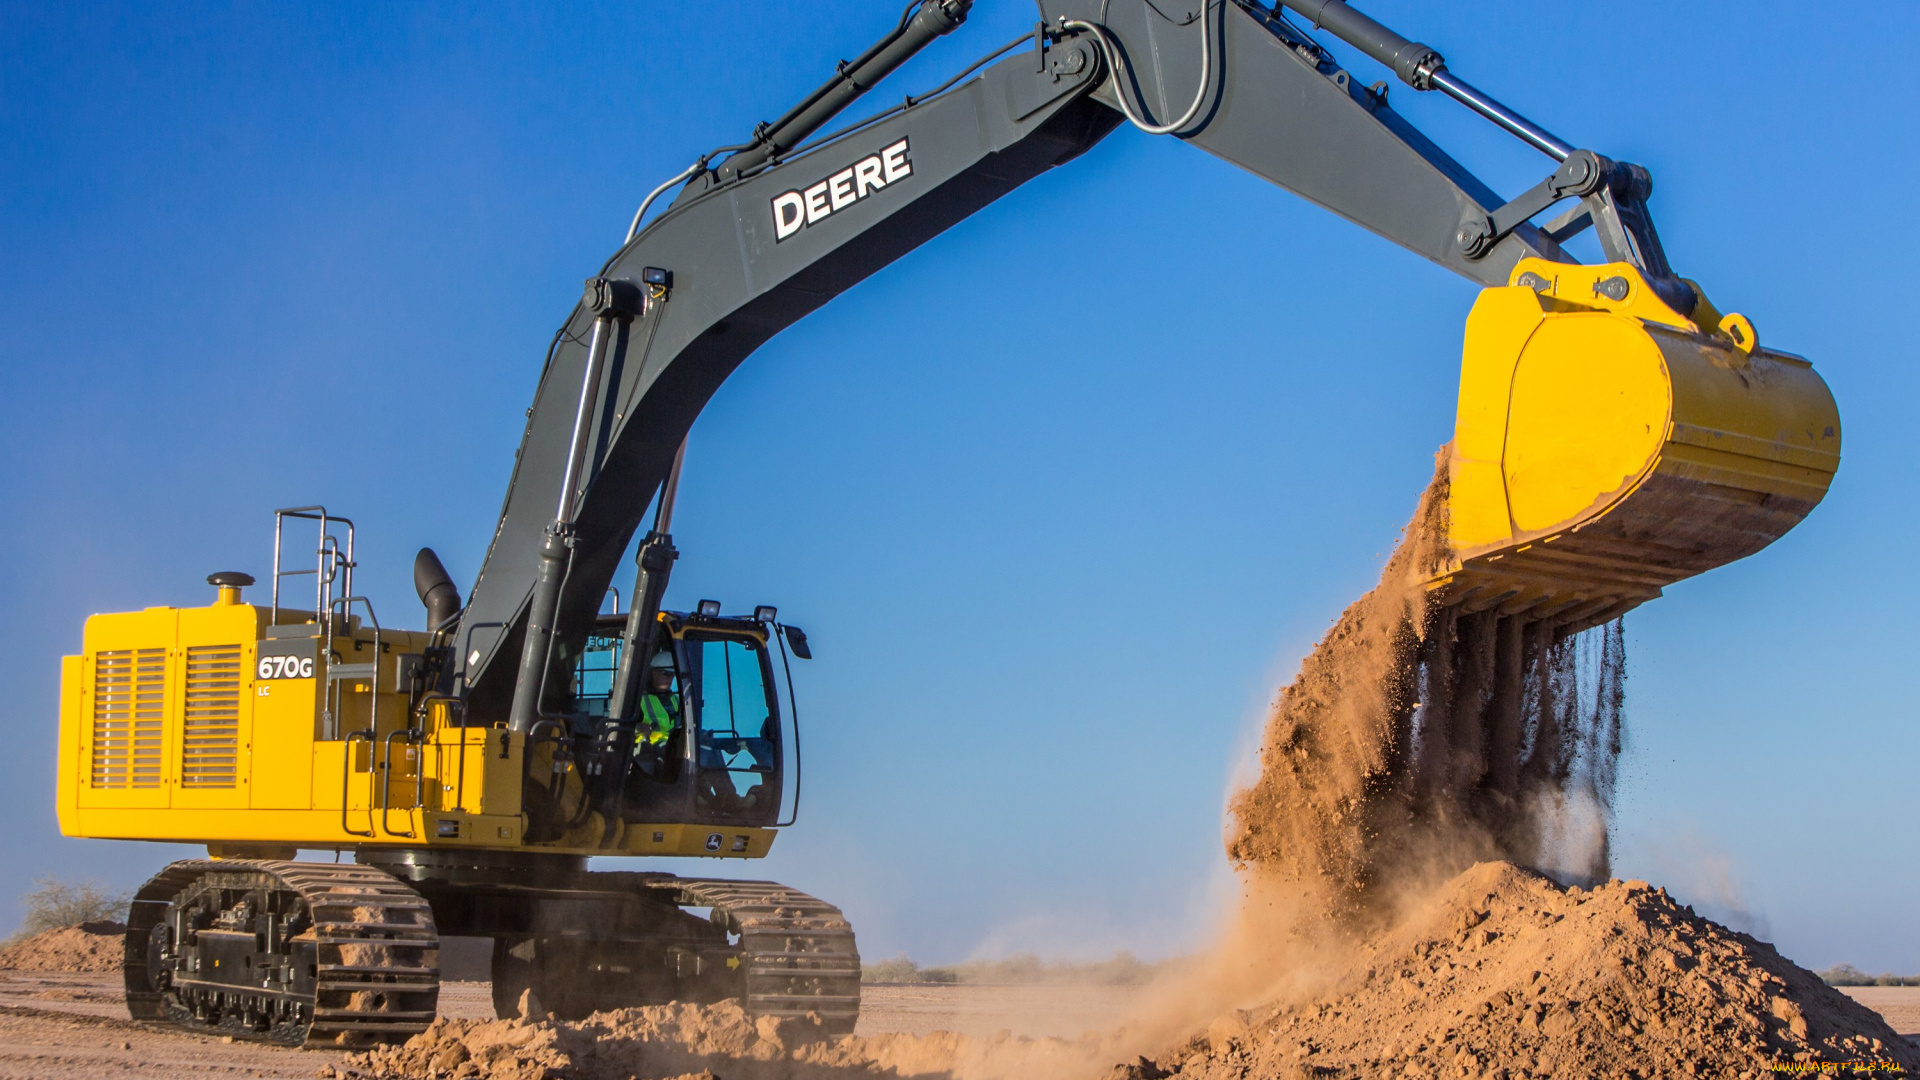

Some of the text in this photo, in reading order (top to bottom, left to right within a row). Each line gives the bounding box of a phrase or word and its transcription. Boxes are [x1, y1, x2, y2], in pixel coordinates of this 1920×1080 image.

[772, 138, 912, 241] DEERE
[258, 655, 313, 679] 670G
[258, 686, 270, 697] LC
